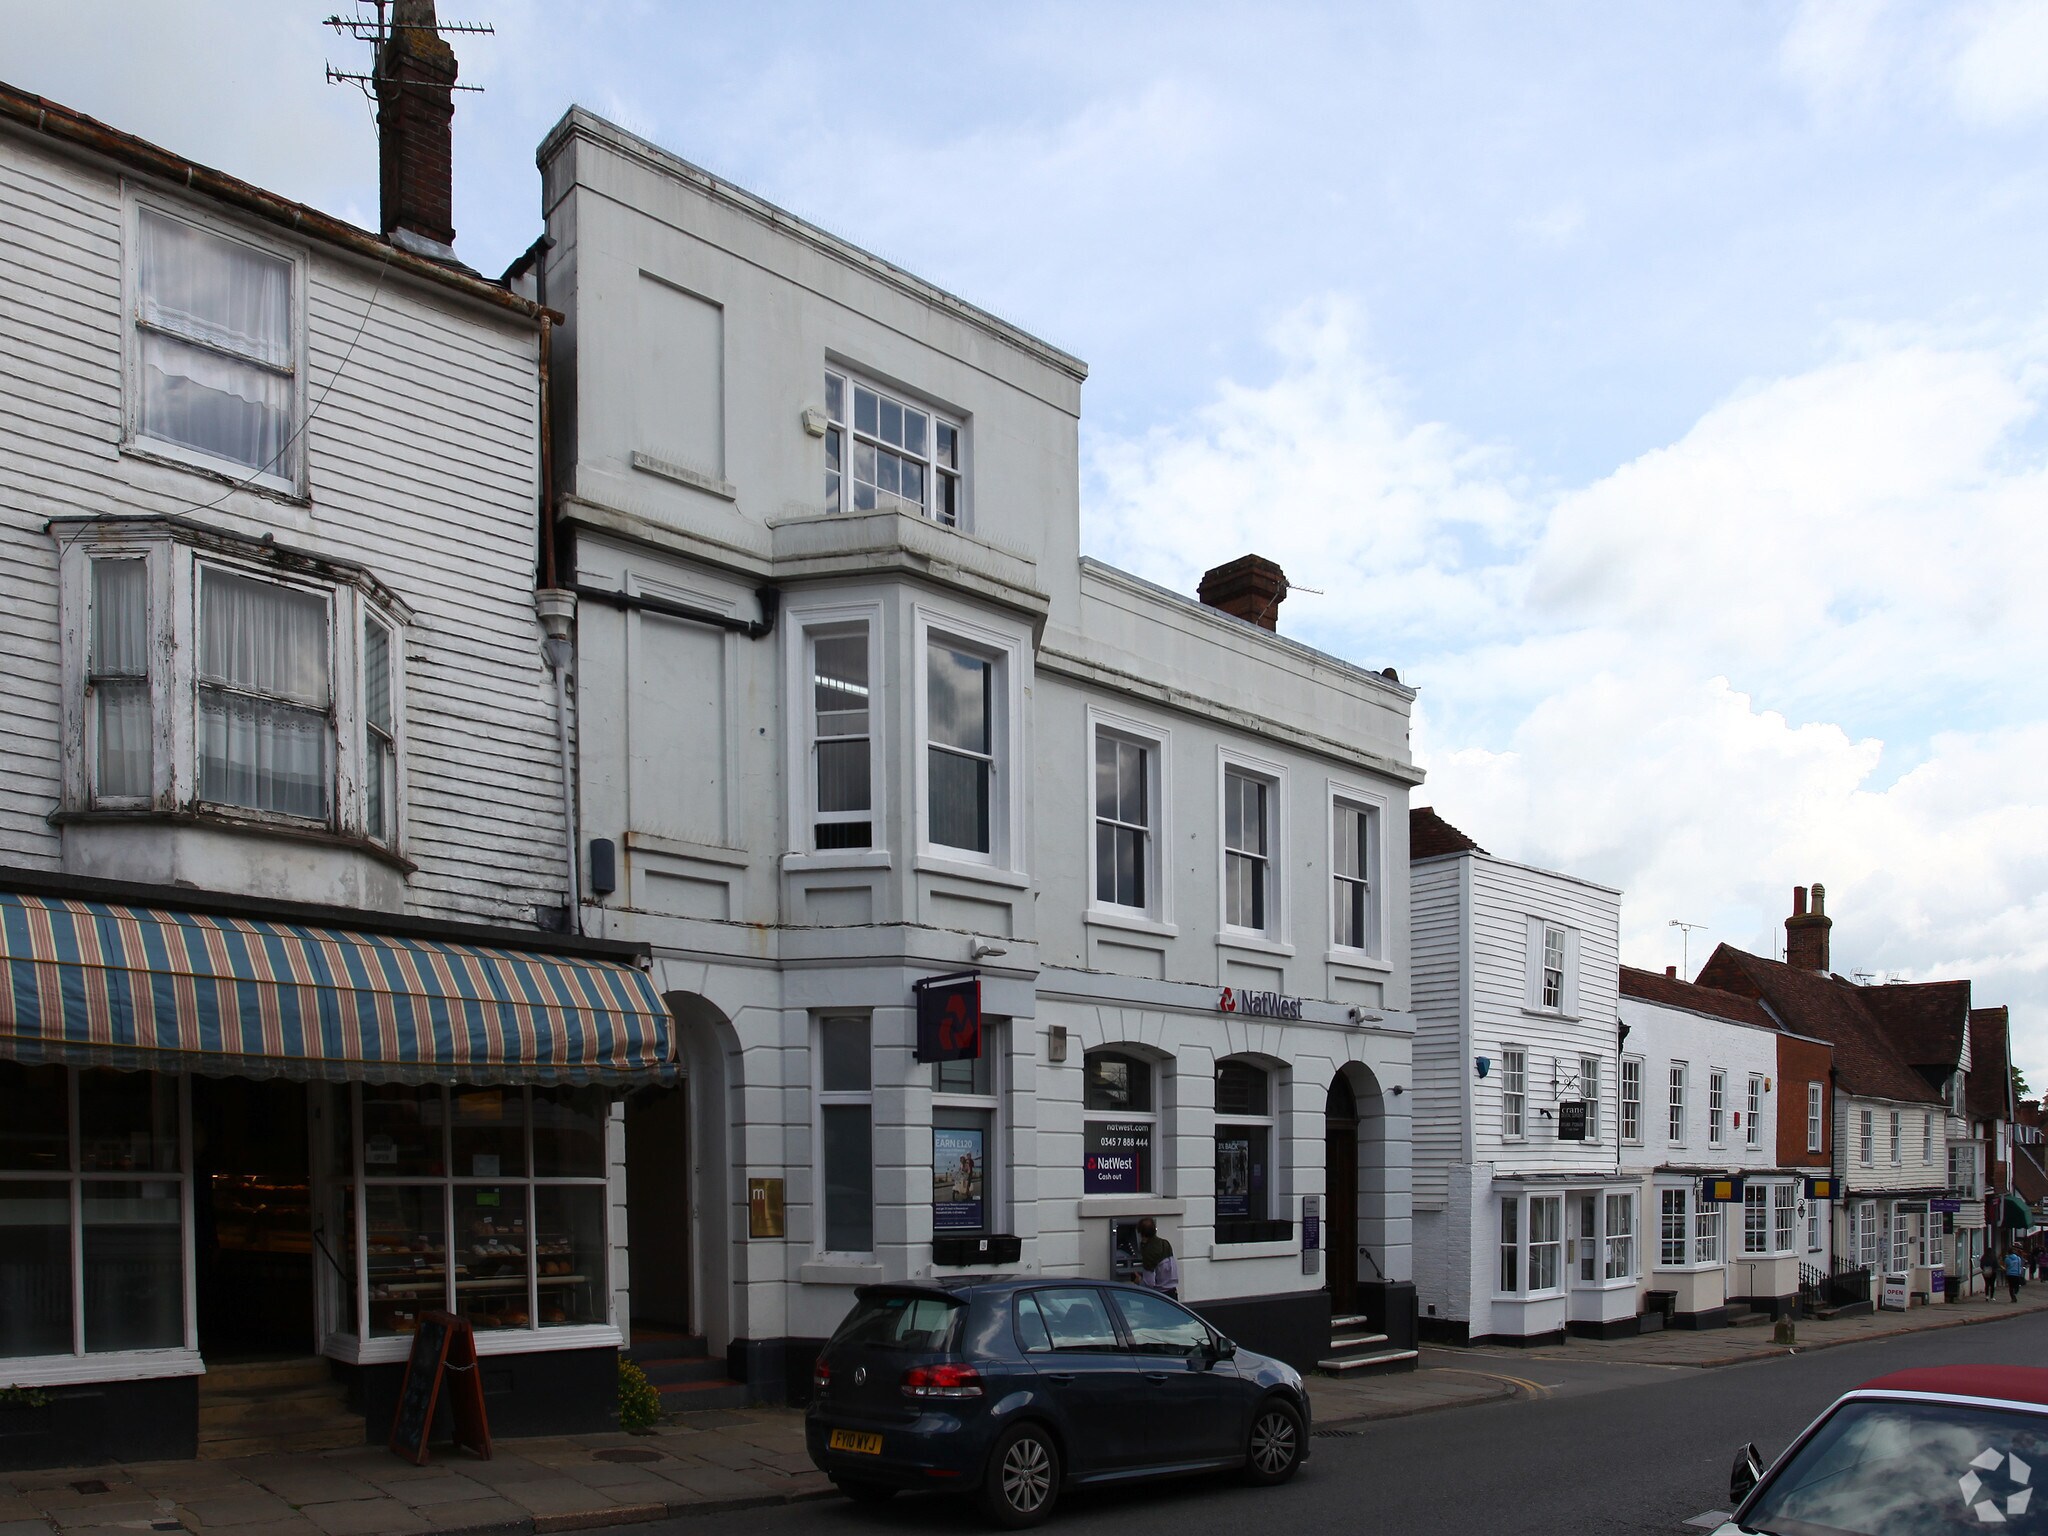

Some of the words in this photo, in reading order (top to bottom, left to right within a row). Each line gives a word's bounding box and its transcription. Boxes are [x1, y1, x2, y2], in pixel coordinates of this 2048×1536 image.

[1241, 989, 1303, 1019] NatWest
[1106, 1123, 1149, 1132] natwest.com
[935, 1138, 956, 1148] EARN
[956, 1139, 973, 1149] £120
[1100, 1137, 1116, 1147] 0345
[1117, 1138, 1121, 1147] 7
[1122, 1138, 1135, 1147] 888
[1136, 1138, 1148, 1147] 444
[1097, 1157, 1133, 1170] NatWest
[1097, 1172, 1112, 1181] Cash
[752, 1188, 765, 1200] m
[1886, 1288, 1904, 1296] OPEN
[836, 1431, 855, 1449] FY10
[856, 1434, 877, 1451] WYJ
